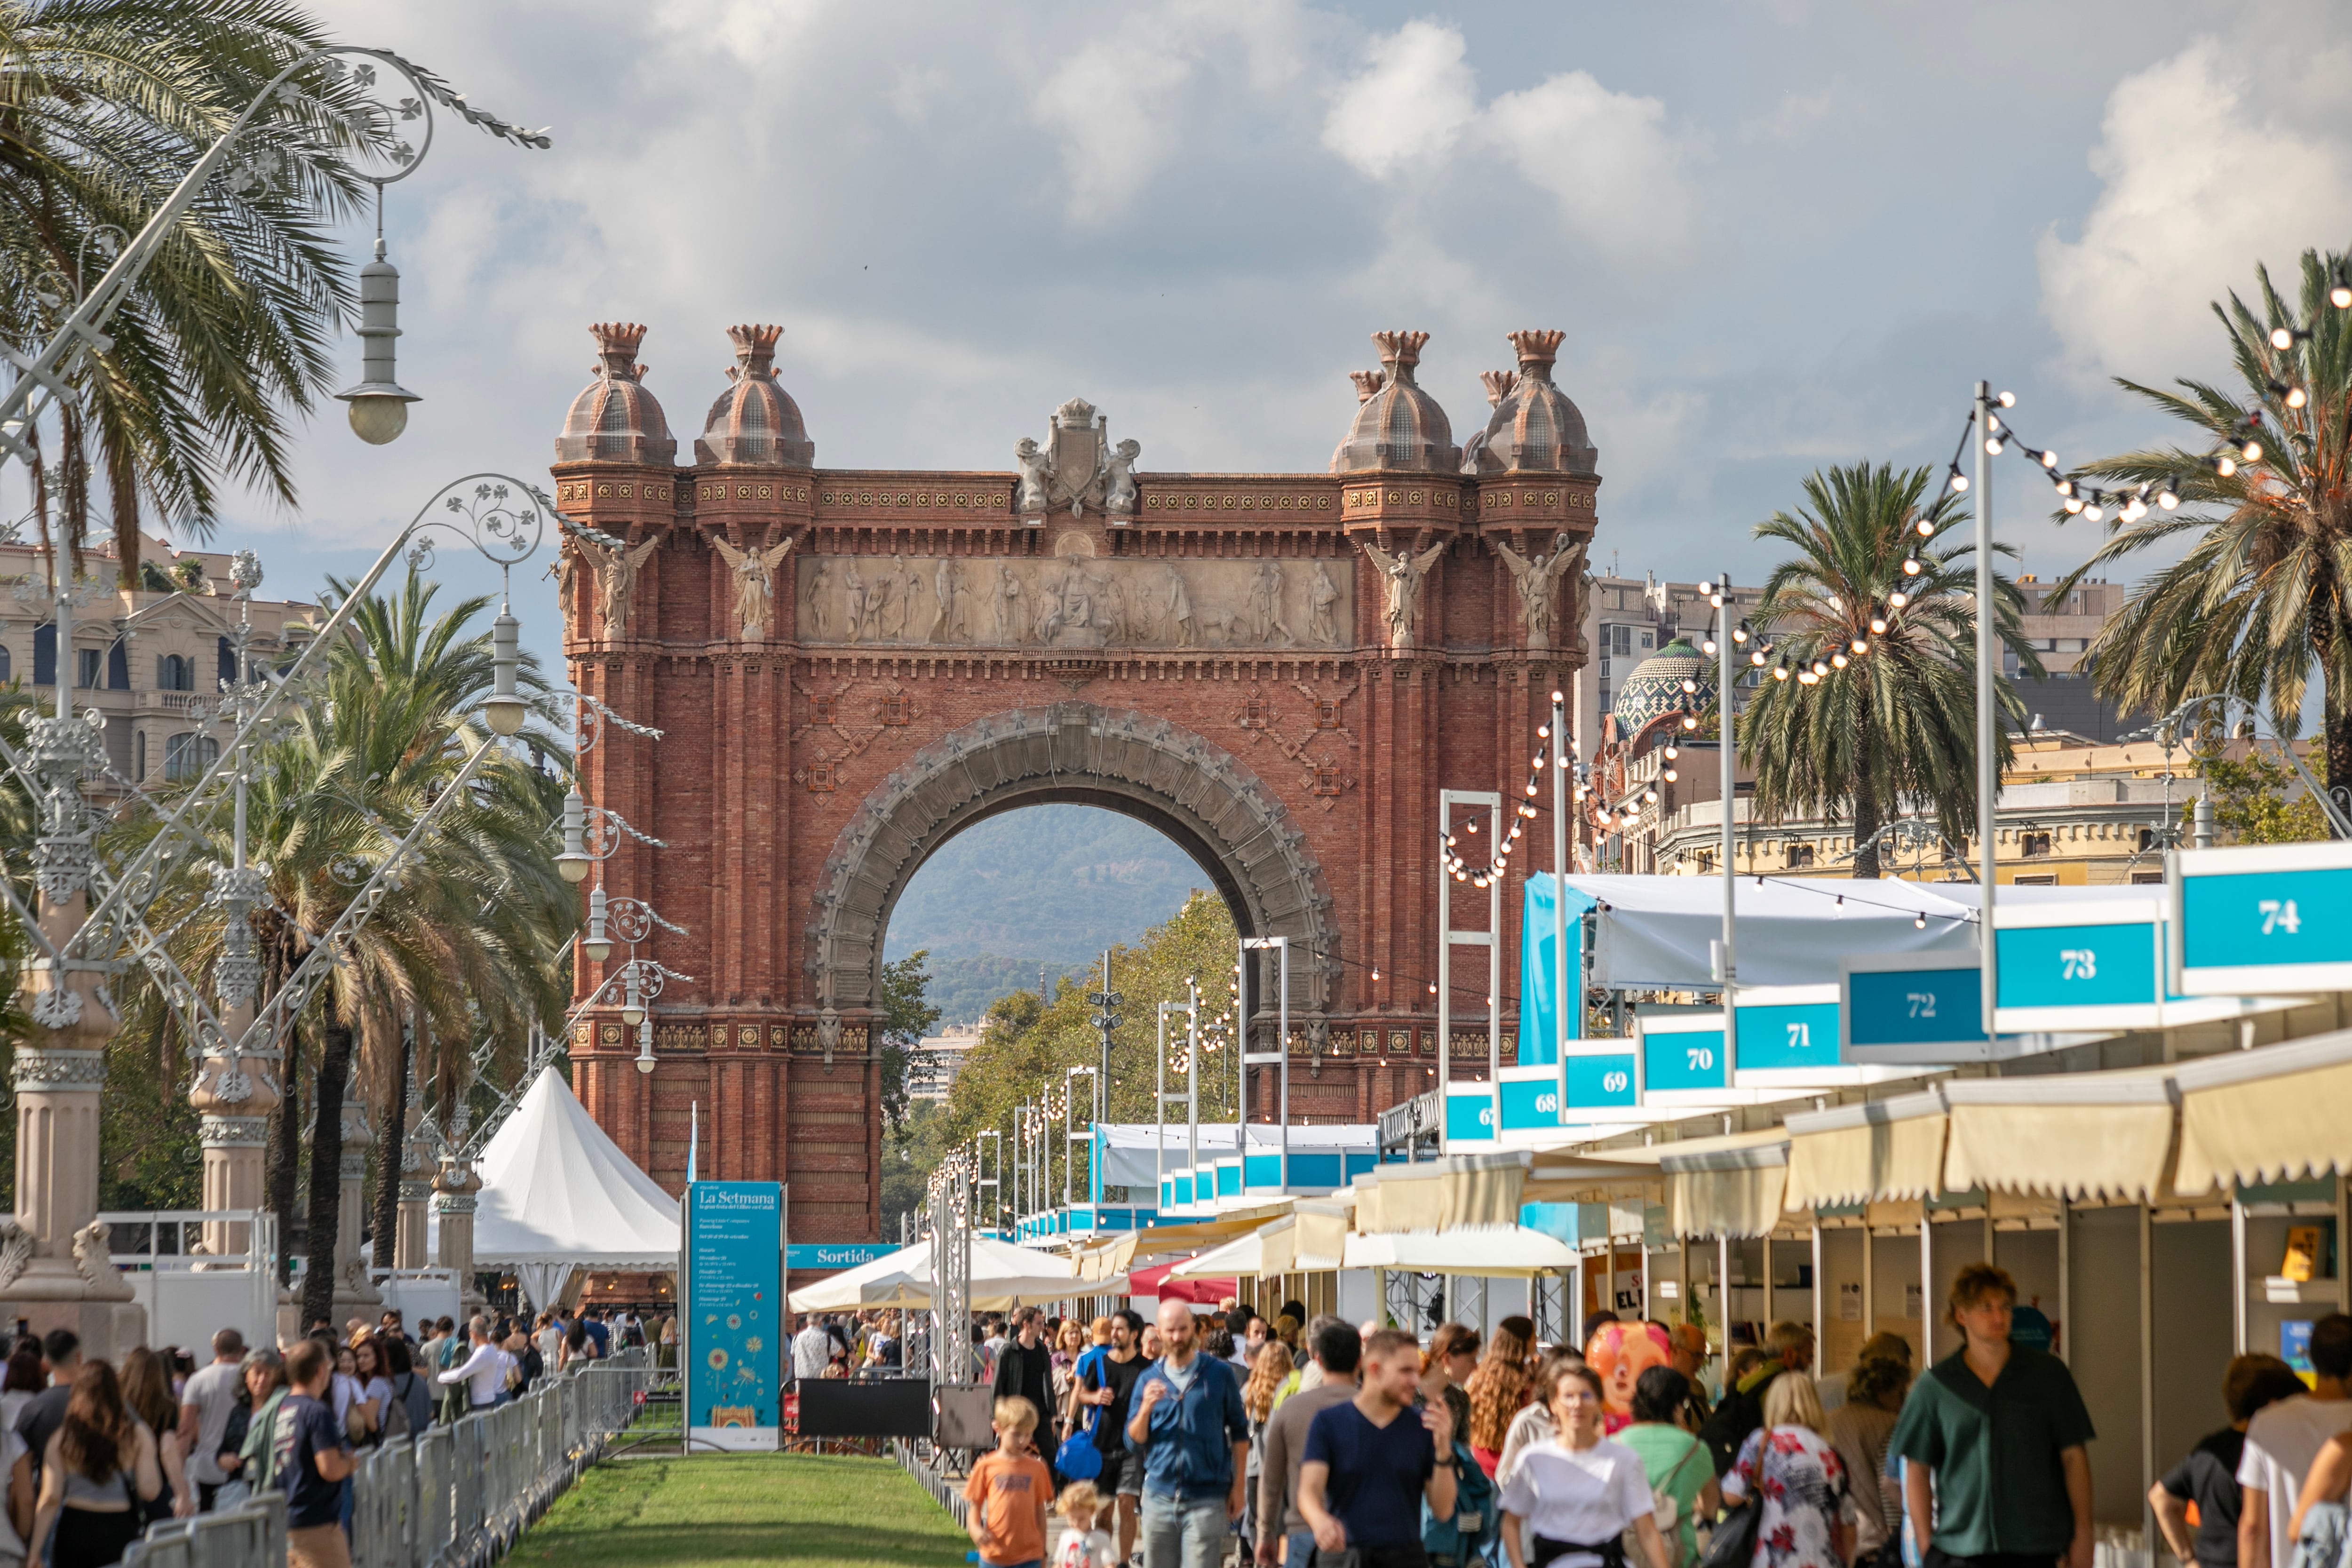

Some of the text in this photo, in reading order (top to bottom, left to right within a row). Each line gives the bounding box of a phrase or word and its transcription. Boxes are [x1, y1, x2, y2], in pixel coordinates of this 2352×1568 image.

[2258, 899, 2302, 935] 74
[2060, 948, 2097, 980] 73
[1907, 992, 1936, 1018] 72
[1786, 1023, 1811, 1048] 71
[1686, 1047, 1713, 1070] 70
[1603, 1071, 1627, 1092] 69
[1535, 1093, 1557, 1113] 68
[700, 1191, 774, 1204] La Setmana
[817, 1248, 874, 1264] Sortida
